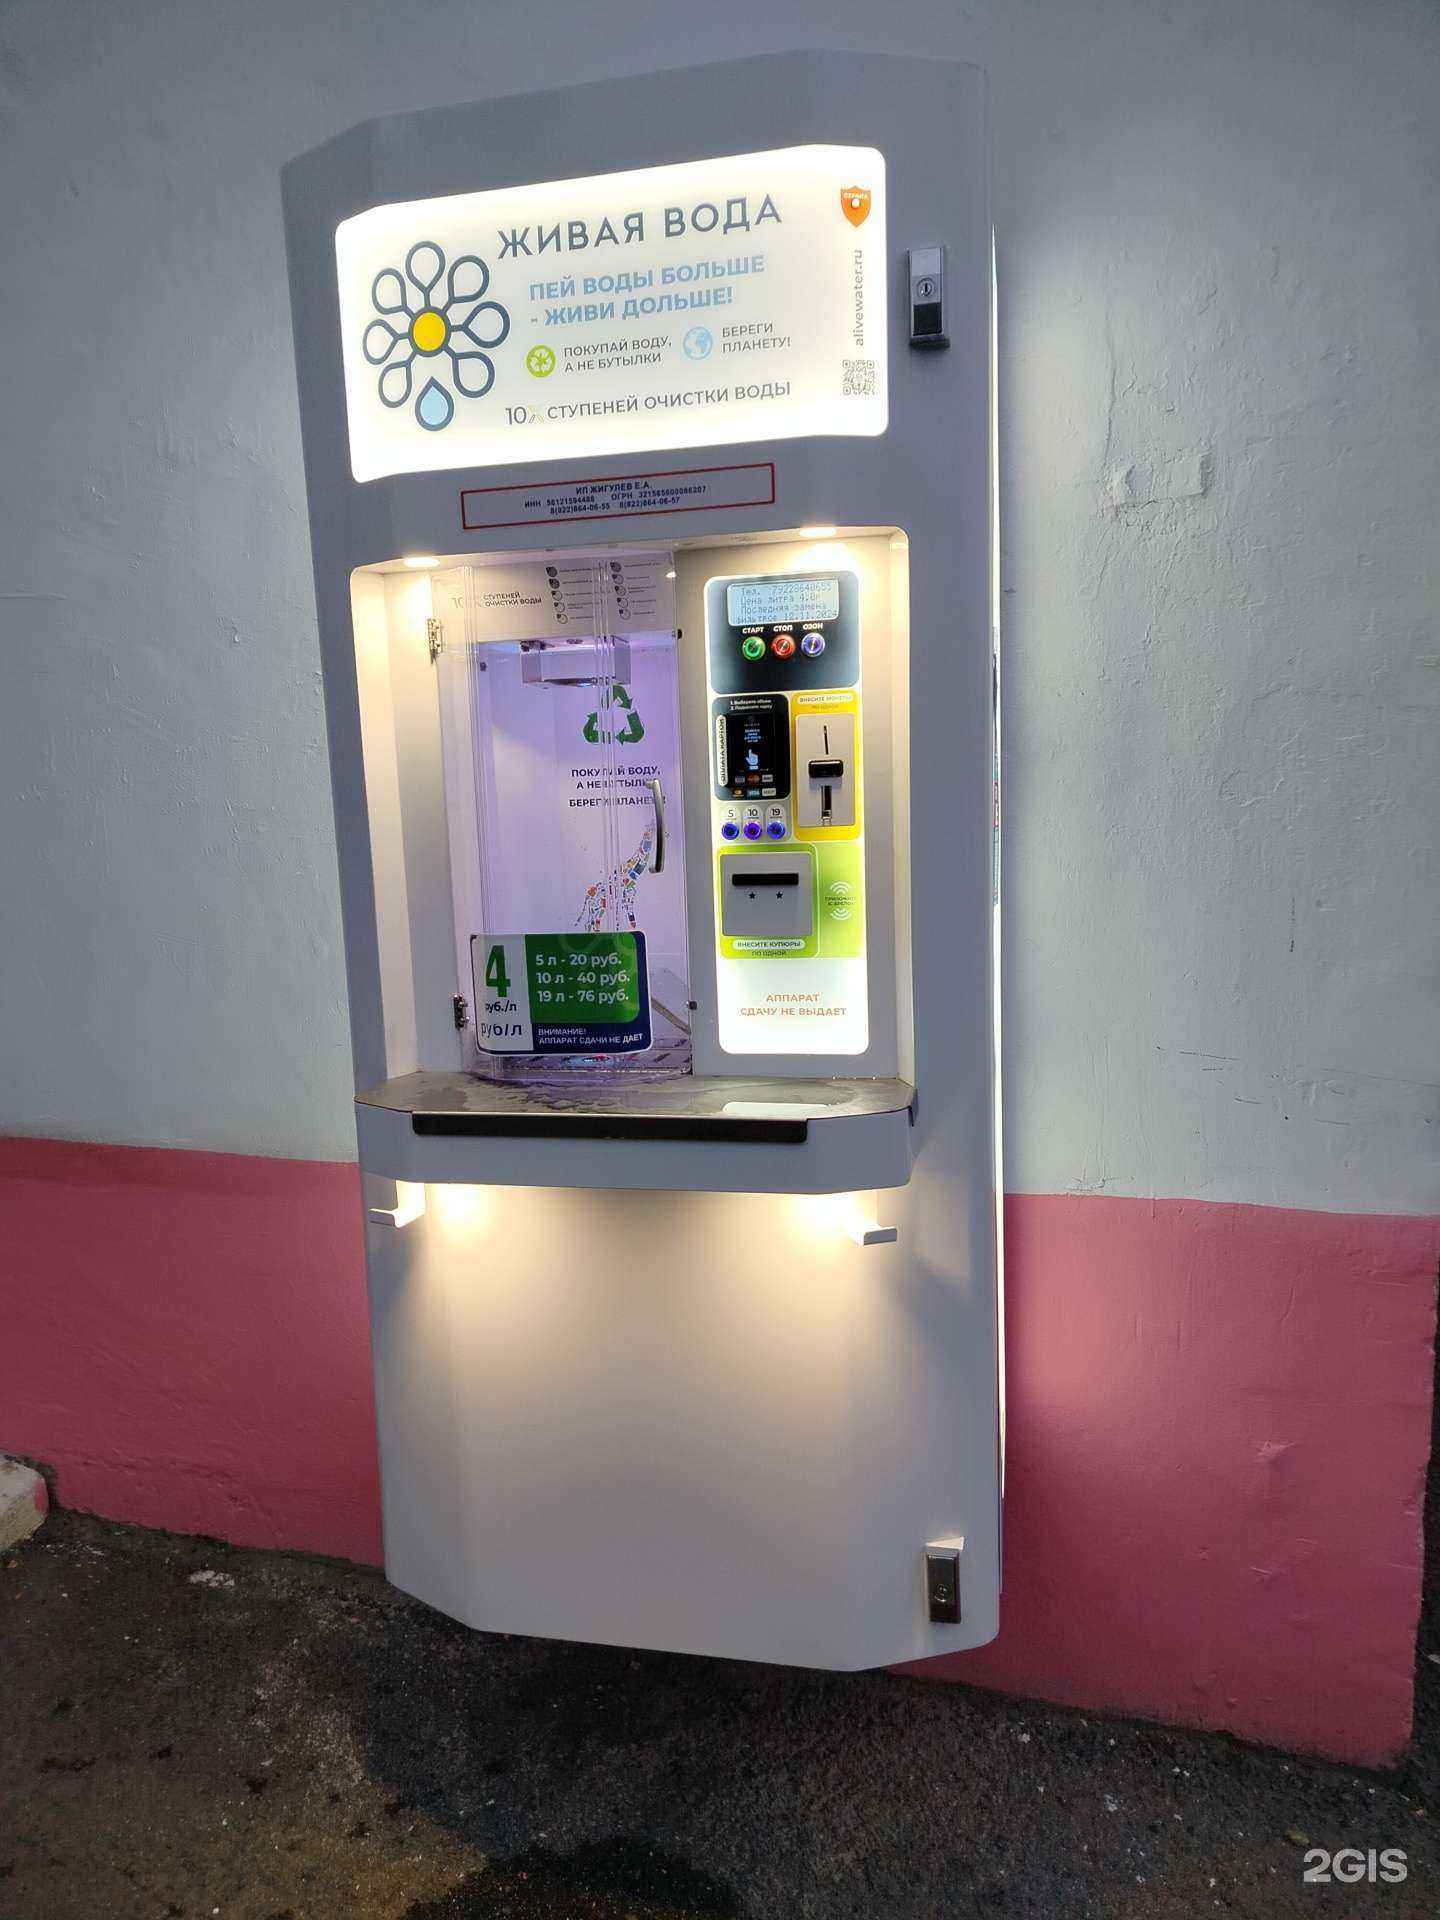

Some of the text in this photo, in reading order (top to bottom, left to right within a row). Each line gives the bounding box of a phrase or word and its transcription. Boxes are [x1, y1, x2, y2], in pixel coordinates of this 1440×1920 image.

[497, 193, 783, 260] ЖИВАЯ ВОДА
[528, 253, 765, 302] ПЕЙ ВОДЫ БОЛЬШЕ
[853, 248, 865, 347] alivewater.ru
[543, 303, 615, 327] ЖИВИ
[621, 286, 734, 322] ДОЛЬШЕ!
[721, 322, 774, 338] БЕРЕГИ
[563, 335, 673, 357] ПОКУПАЙ ВОДУ,
[721, 336, 792, 354] ПЛАНЕТУ!
[565, 353, 661, 373] А НЕ БУТЫЛКИ
[505, 381, 791, 427] 10 СТУПЕНЕЙ ОЧИСТКИ ВОДЫ
[576, 485, 588, 495] ИП
[590, 481, 633, 494] ЖИГУЛЕВ
[524, 499, 542, 508] ИНН
[611, 492, 633, 501] ОГРН
[483, 591, 521, 600] СТУПЕНЕЙ
[485, 597, 542, 607] ОЧИСТКИ ВОДЫ
[773, 624, 793, 632] СТОП
[628, 766, 660, 775] ВОДУ,
[576, 781, 584, 789] А
[587, 780, 602, 789] НЕ
[728, 809, 734, 817] 5
[748, 808, 758, 816] 10
[771, 808, 781, 816] 19
[535, 955, 544, 965] 5
[547, 955, 557, 966] л
[570, 955, 588, 965] 20
[591, 953, 622, 968] руб.
[485, 944, 511, 998] 4
[536, 973, 551, 983] 10
[554, 973, 564, 983] л
[577, 972, 596, 983] 40
[600, 970, 630, 987] руб.
[538, 991, 552, 1002] 19
[555, 991, 565, 1002] л
[577, 991, 595, 1001] 76
[598, 989, 629, 1004] руб.
[766, 994, 819, 1002] АППАРАТ
[485, 1001, 517, 1014] руб./л
[740, 1008, 846, 1016] СДАЧУ НЕ ВЫДАЕТ
[481, 1023, 523, 1038] руб/л
[538, 1028, 586, 1036] ВНИМАНИЕ!
[579, 1036, 607, 1044] СДАЧИ
[622, 1033, 643, 1043] ДАЕТ
